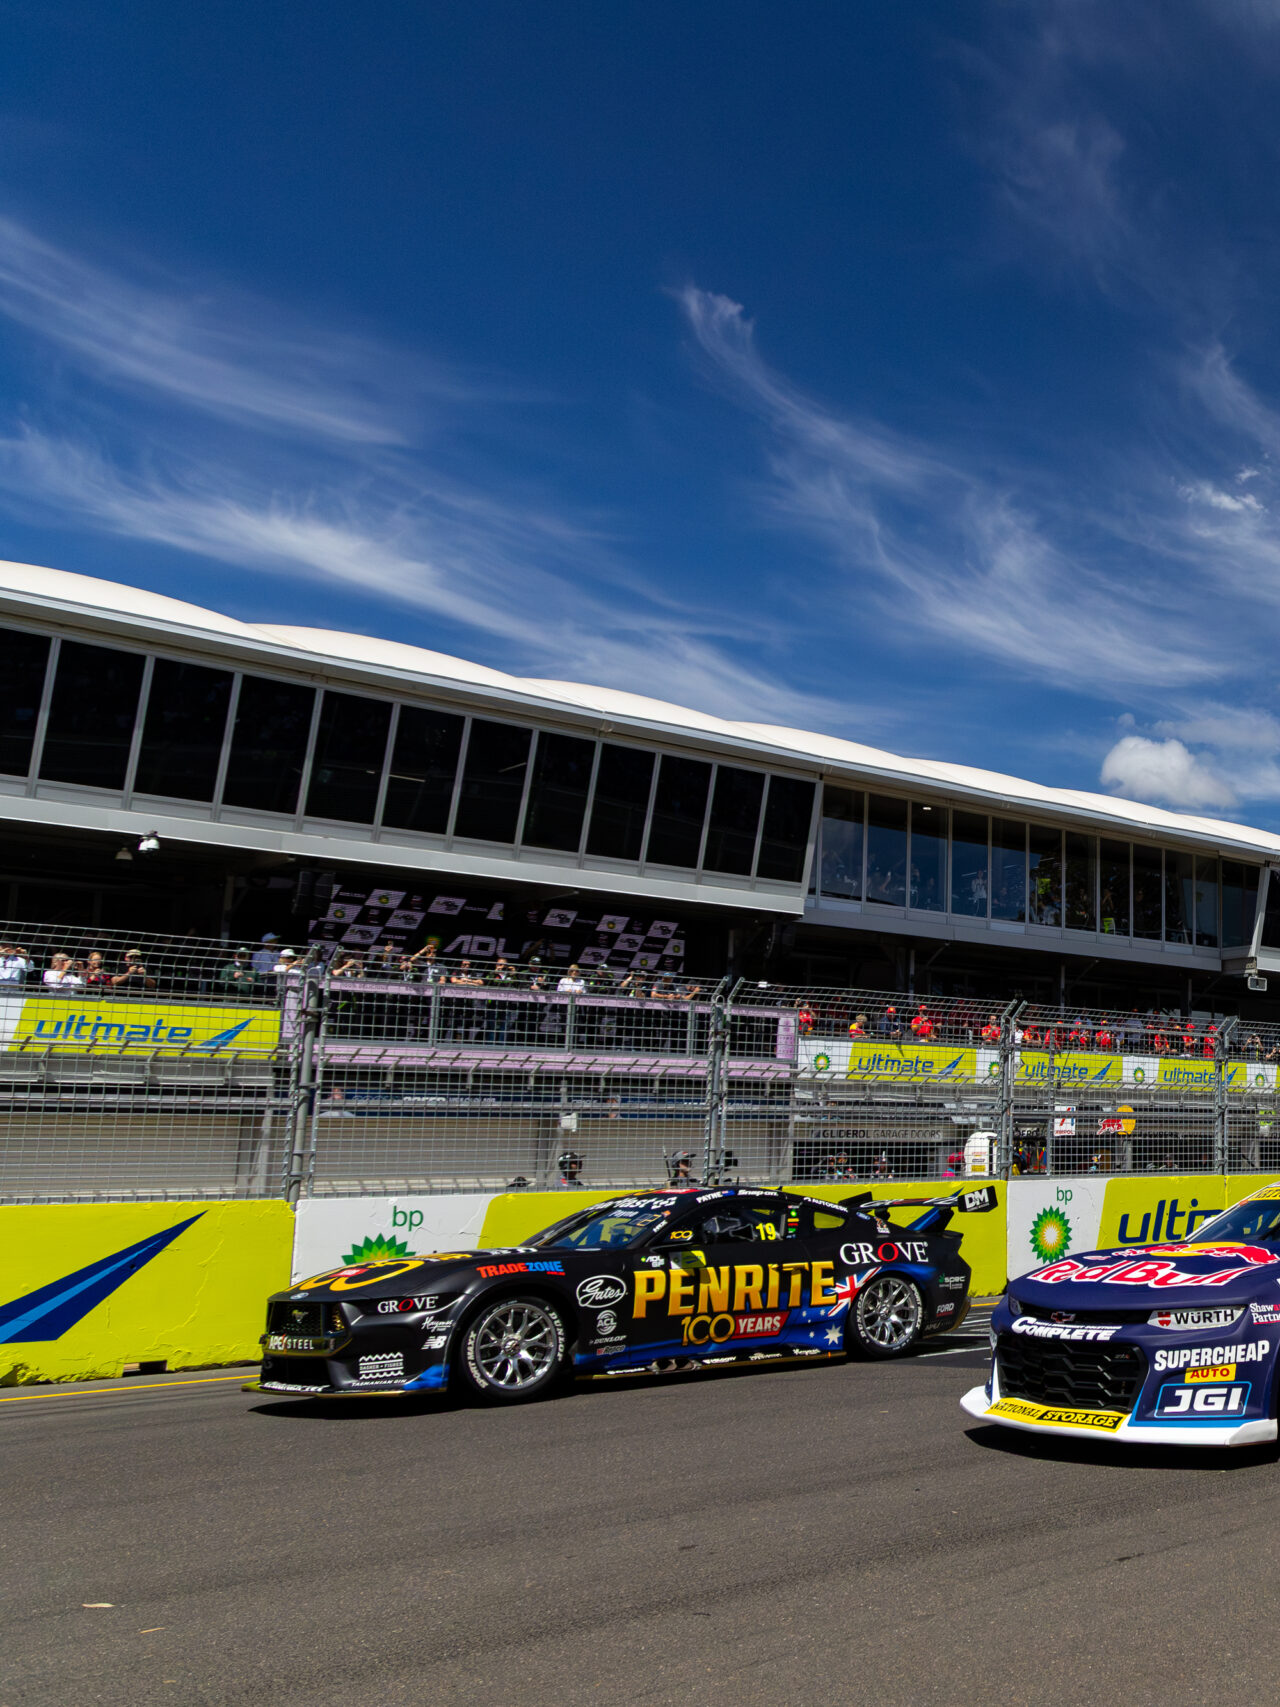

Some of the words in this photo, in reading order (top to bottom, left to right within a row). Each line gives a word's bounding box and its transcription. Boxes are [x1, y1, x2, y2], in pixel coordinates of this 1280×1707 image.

[35, 1014, 193, 1044] ultimate
[857, 1054, 934, 1073] ultimate
[1024, 1062, 1088, 1080] ultimate
[1163, 1067, 1216, 1084] ultimate
[822, 1129, 870, 1139] GLIDEROL
[696, 1191, 722, 1203] PAYNE
[738, 1189, 778, 1197] Snap-on
[1056, 1186, 1073, 1205] bp
[812, 1199, 848, 1213] AUTODESK
[392, 1206, 424, 1231] bp
[756, 1222, 776, 1241] 19
[840, 1242, 928, 1266] GROVE
[476, 1260, 564, 1278] TRADEZONE
[1028, 1259, 1135, 1284] Red
[1102, 1260, 1266, 1288] Bull
[584, 1279, 623, 1302] Gates
[632, 1261, 837, 1319] PENRITE
[377, 1296, 437, 1314] GROVE
[936, 1303, 955, 1314] FORD
[596, 1318, 617, 1327] ACL
[738, 1314, 781, 1334] YEARS
[1174, 1309, 1235, 1325] WÜRTH
[551, 1311, 566, 1362] DUNLOP
[681, 1313, 736, 1347] 100
[1011, 1316, 1117, 1341] COMPLETE
[286, 1339, 315, 1350] STEEL
[465, 1331, 477, 1362] MAXX
[597, 1336, 627, 1344] DUNLOP
[384, 1361, 403, 1369] FISHER
[1154, 1340, 1270, 1371] SUPERCHEAP
[468, 1363, 488, 1389] SPORT
[1190, 1366, 1231, 1379] AUTO
[1164, 1388, 1243, 1412] JGI
[990, 1400, 1041, 1418] NATIONAL
[1044, 1410, 1117, 1428] STORAGE
